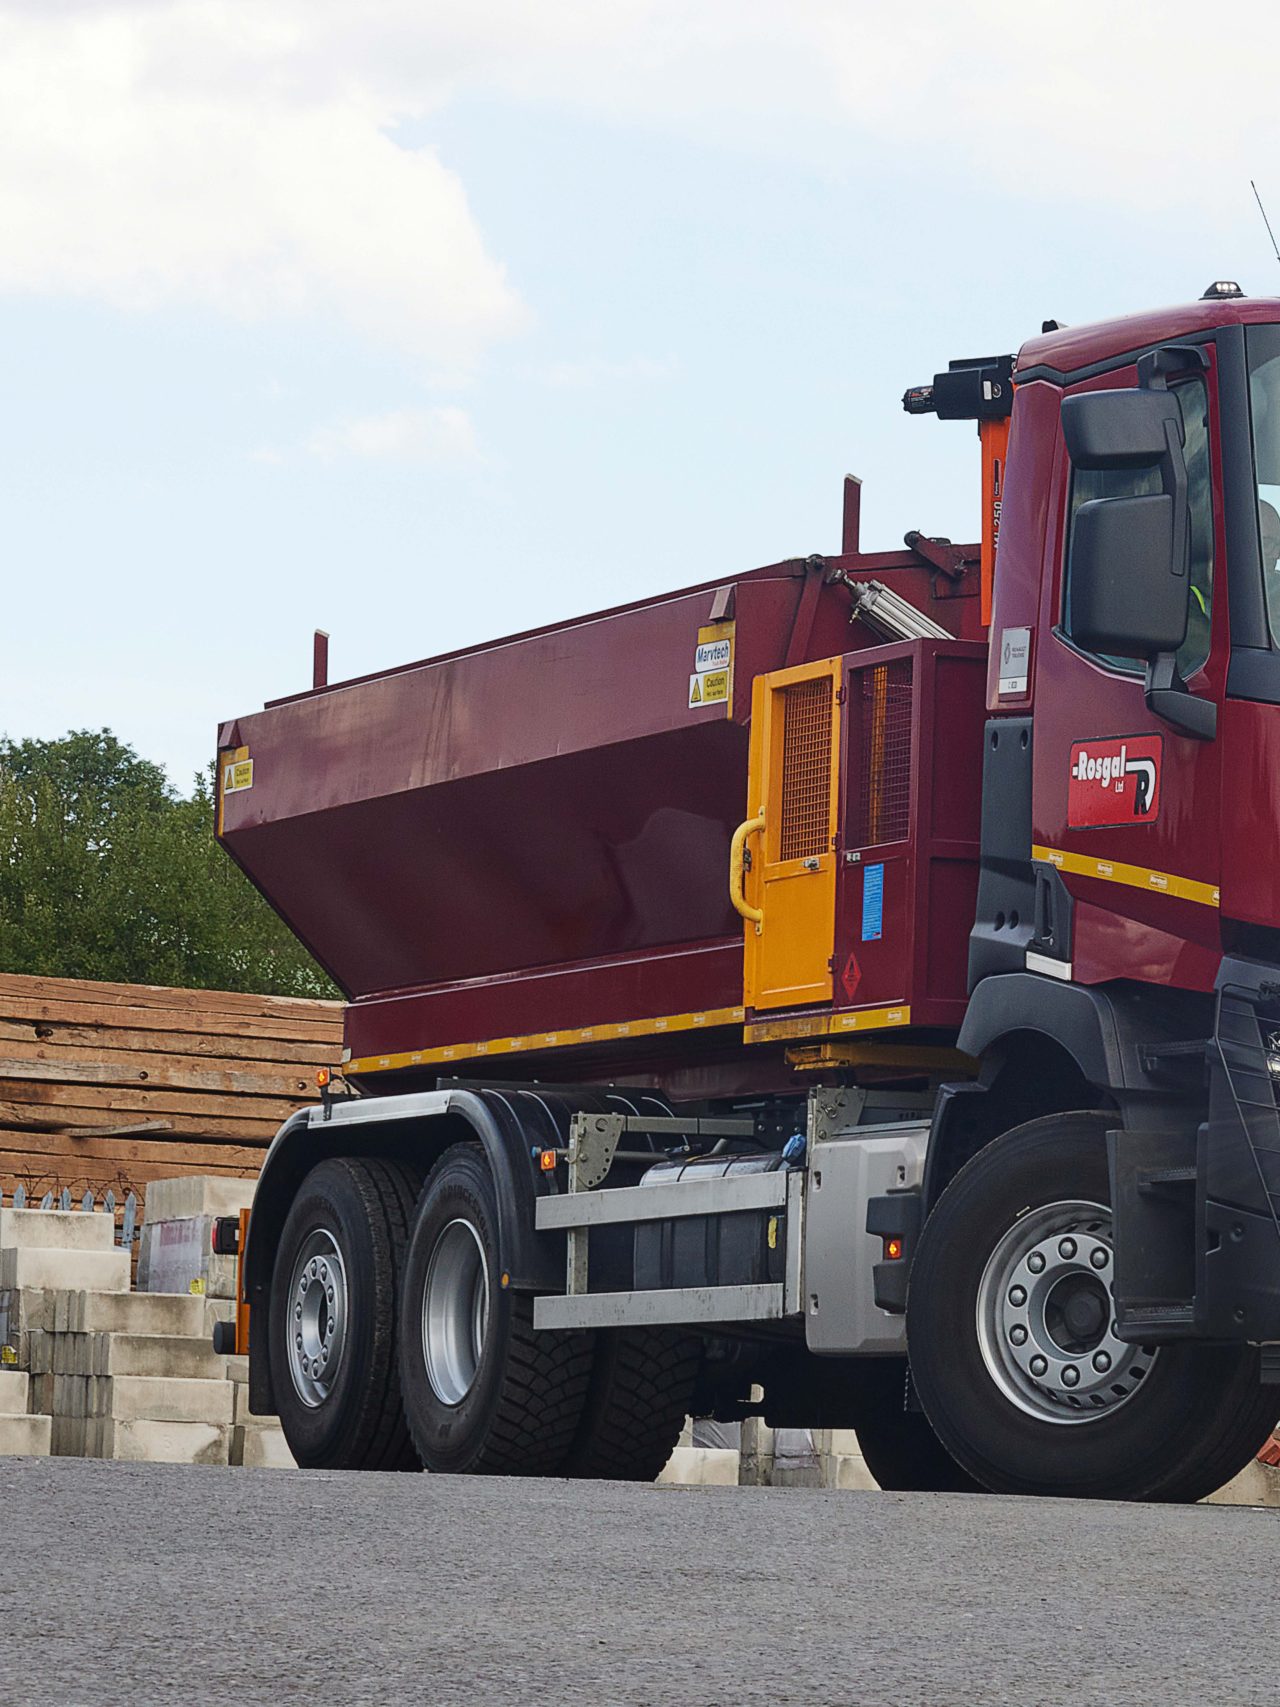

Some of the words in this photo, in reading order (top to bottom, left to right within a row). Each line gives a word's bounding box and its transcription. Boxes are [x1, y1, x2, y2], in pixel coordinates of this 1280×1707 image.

[993, 501, 1003, 526] 250
[697, 642, 729, 663] Marvtech
[706, 677, 725, 688] Caution
[1078, 745, 1126, 788] Rosgal
[1115, 780, 1124, 793] Ltd
